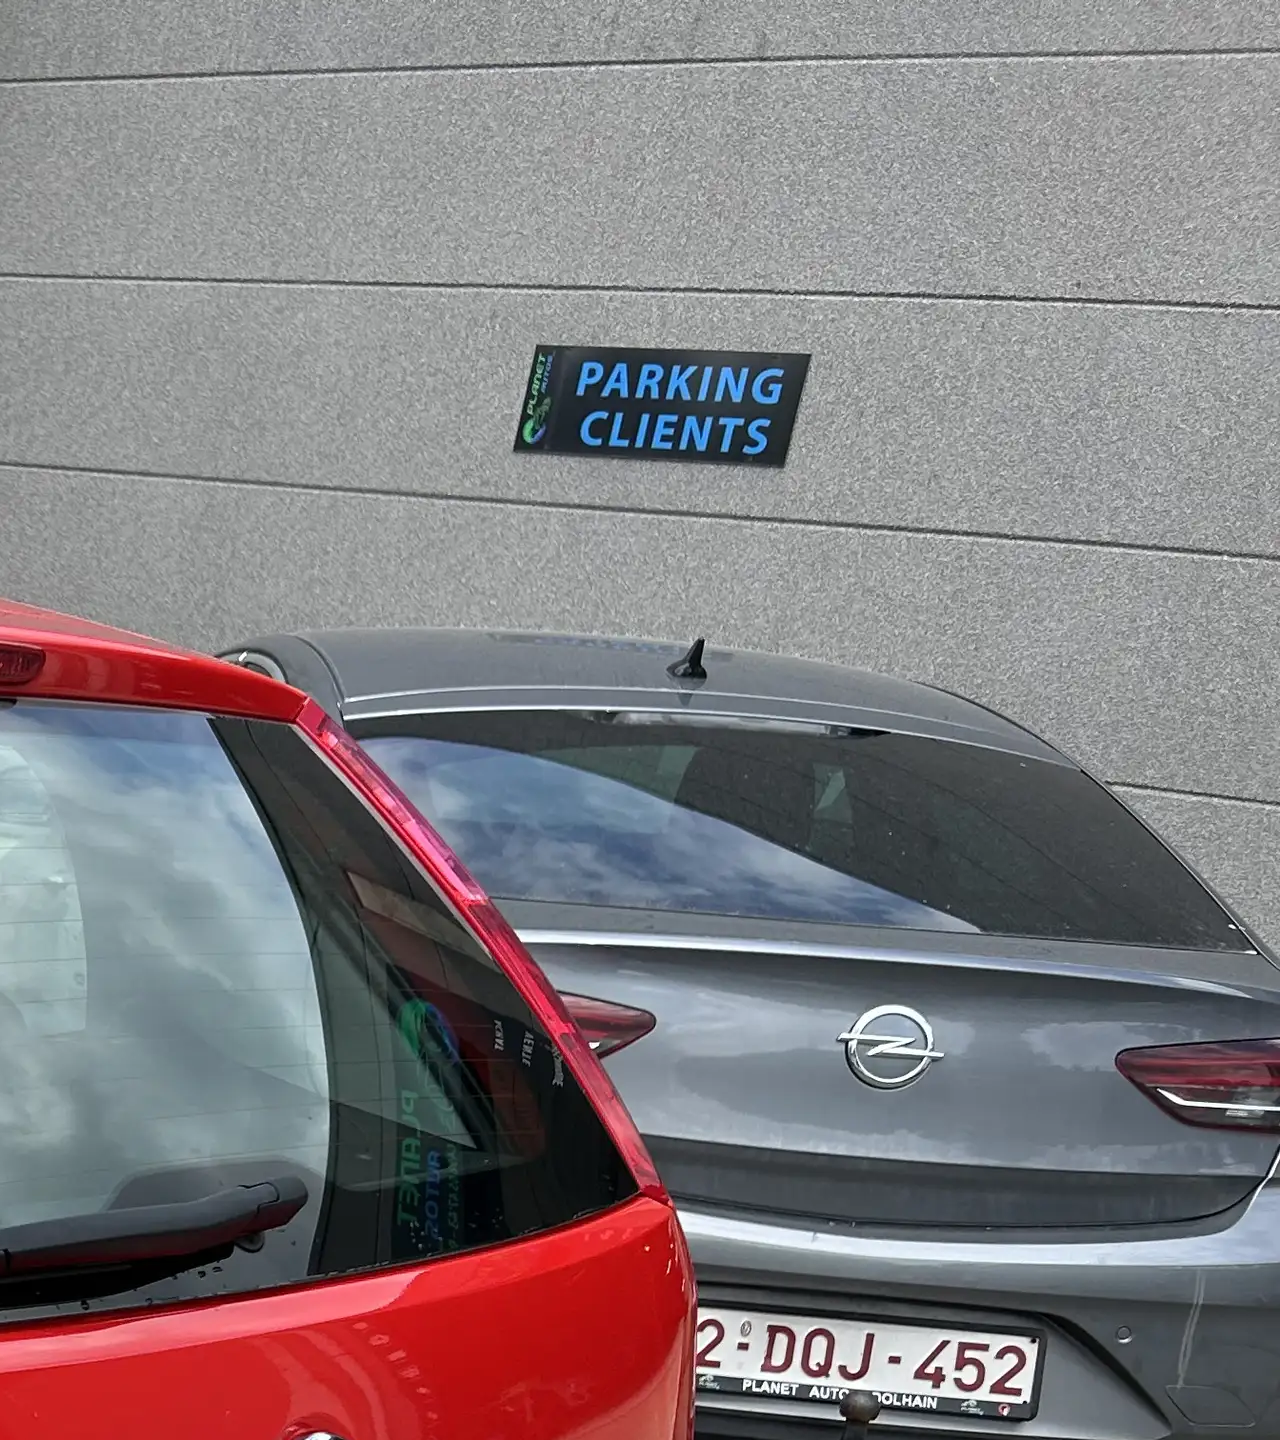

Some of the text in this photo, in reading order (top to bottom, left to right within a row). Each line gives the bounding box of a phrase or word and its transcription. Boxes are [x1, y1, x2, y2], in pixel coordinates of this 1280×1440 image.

[527, 352, 546, 415] PLANET
[576, 361, 785, 405] PARKING
[580, 410, 771, 455] CLIENTS
[742, 1378, 800, 1397] PLANET
[808, 1385, 851, 1401] AUTO
